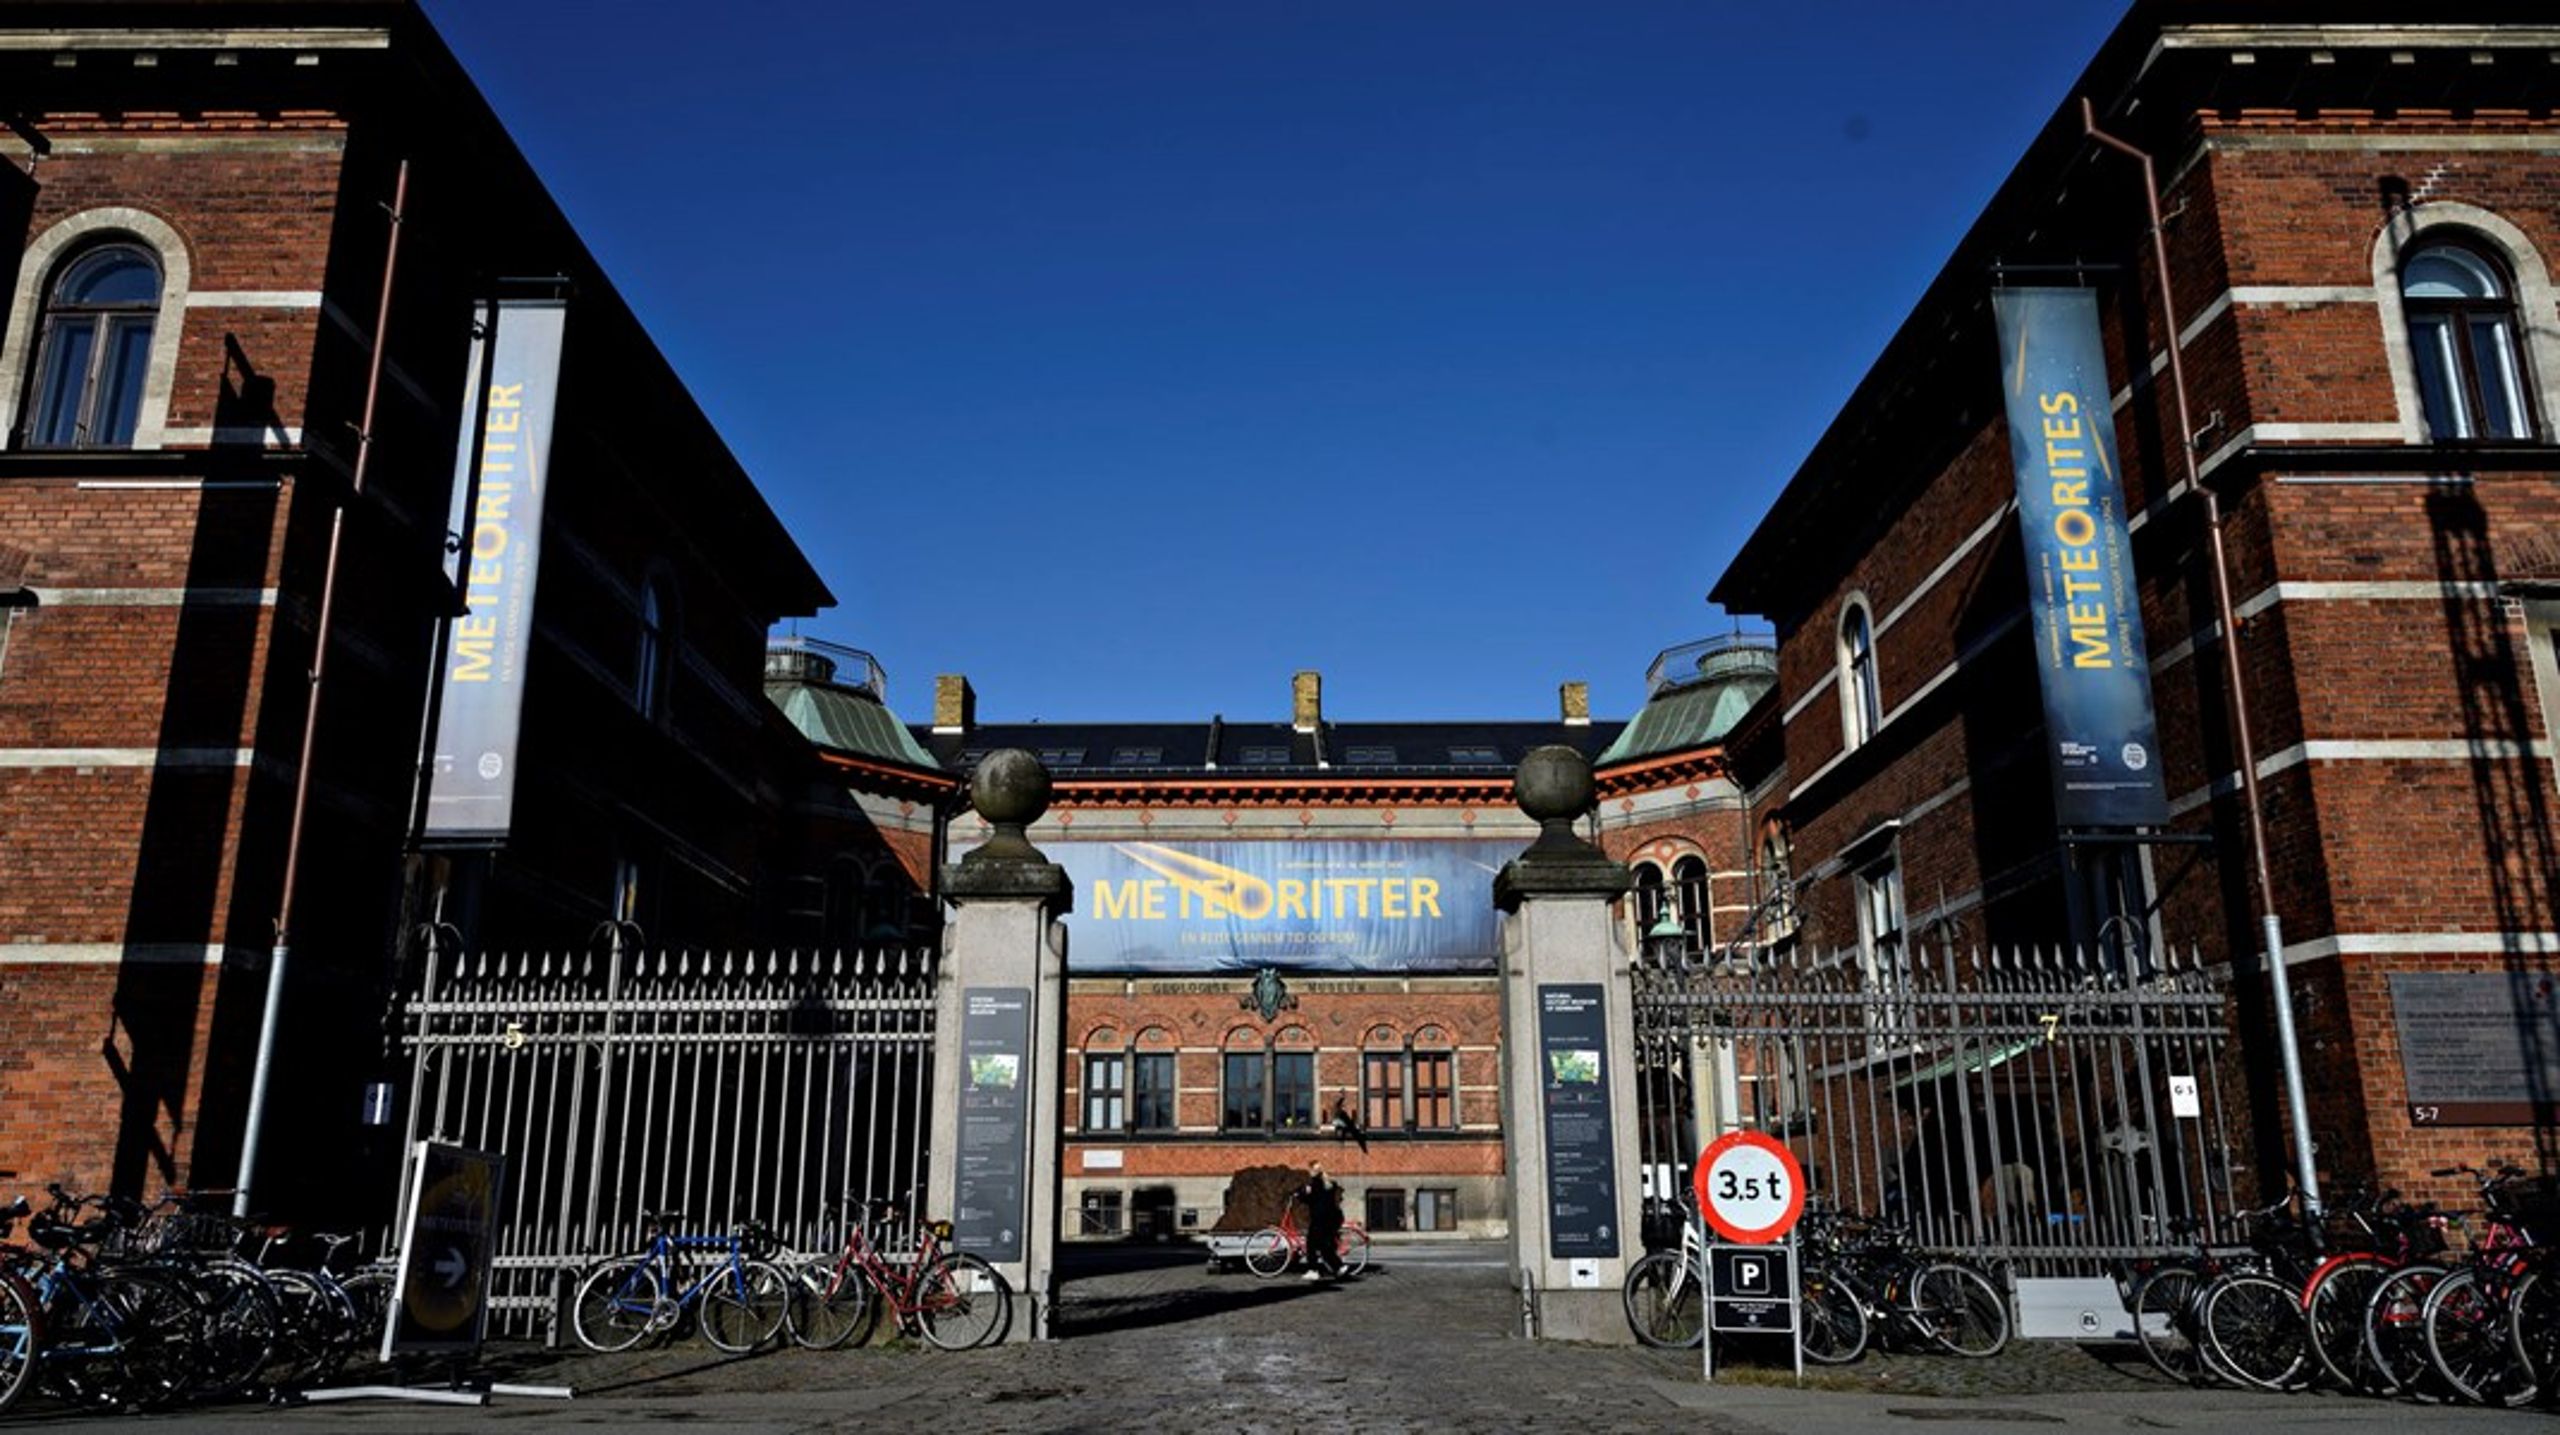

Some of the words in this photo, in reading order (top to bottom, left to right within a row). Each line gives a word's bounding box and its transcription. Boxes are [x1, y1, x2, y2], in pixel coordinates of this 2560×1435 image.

[452, 382, 524, 686] METEORITTER
[2040, 390, 2113, 671] METEORITES
[1093, 878, 1442, 920] METEORITTER
[504, 1022, 524, 1049] 5
[2039, 1015, 2059, 1041] 7
[2415, 1107, 2439, 1121] 5-7
[1766, 1171, 1782, 1200] t
[1741, 1263, 1760, 1286] P
